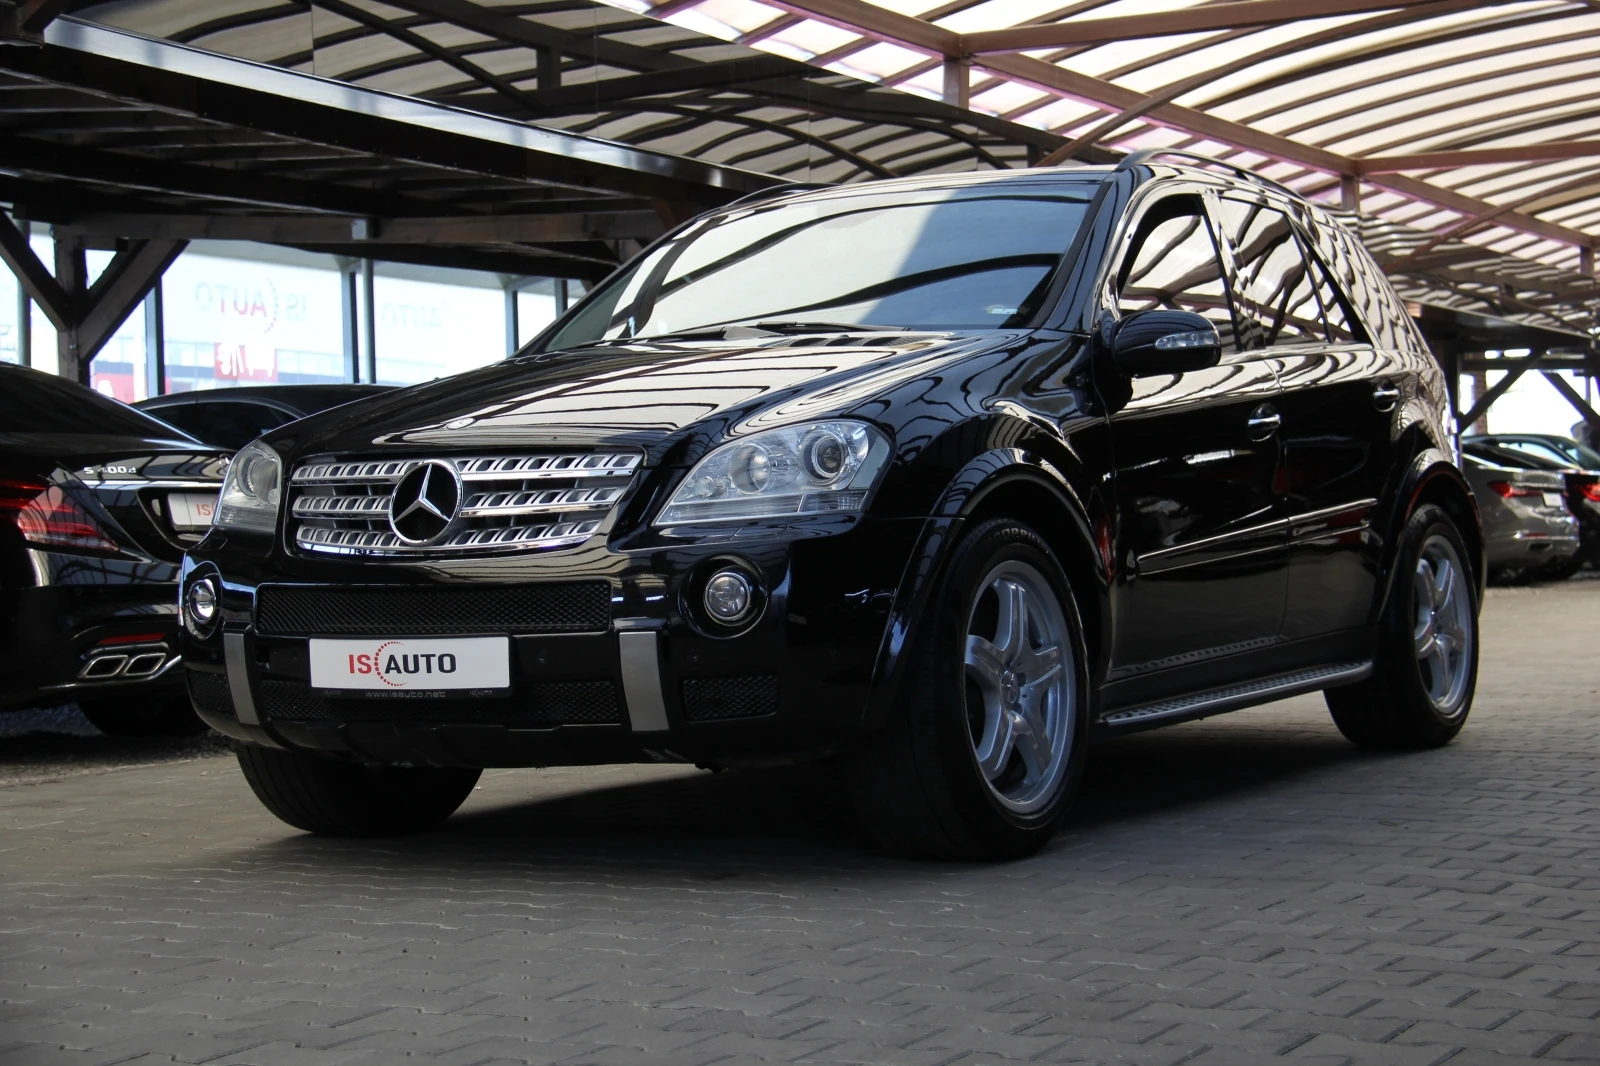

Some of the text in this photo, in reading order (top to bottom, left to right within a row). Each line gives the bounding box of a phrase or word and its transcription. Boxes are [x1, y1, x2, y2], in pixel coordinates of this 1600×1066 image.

[196, 503, 211, 516] IS
[348, 653, 457, 675] IS AUTO
[365, 690, 447, 699] www.isauto.net
